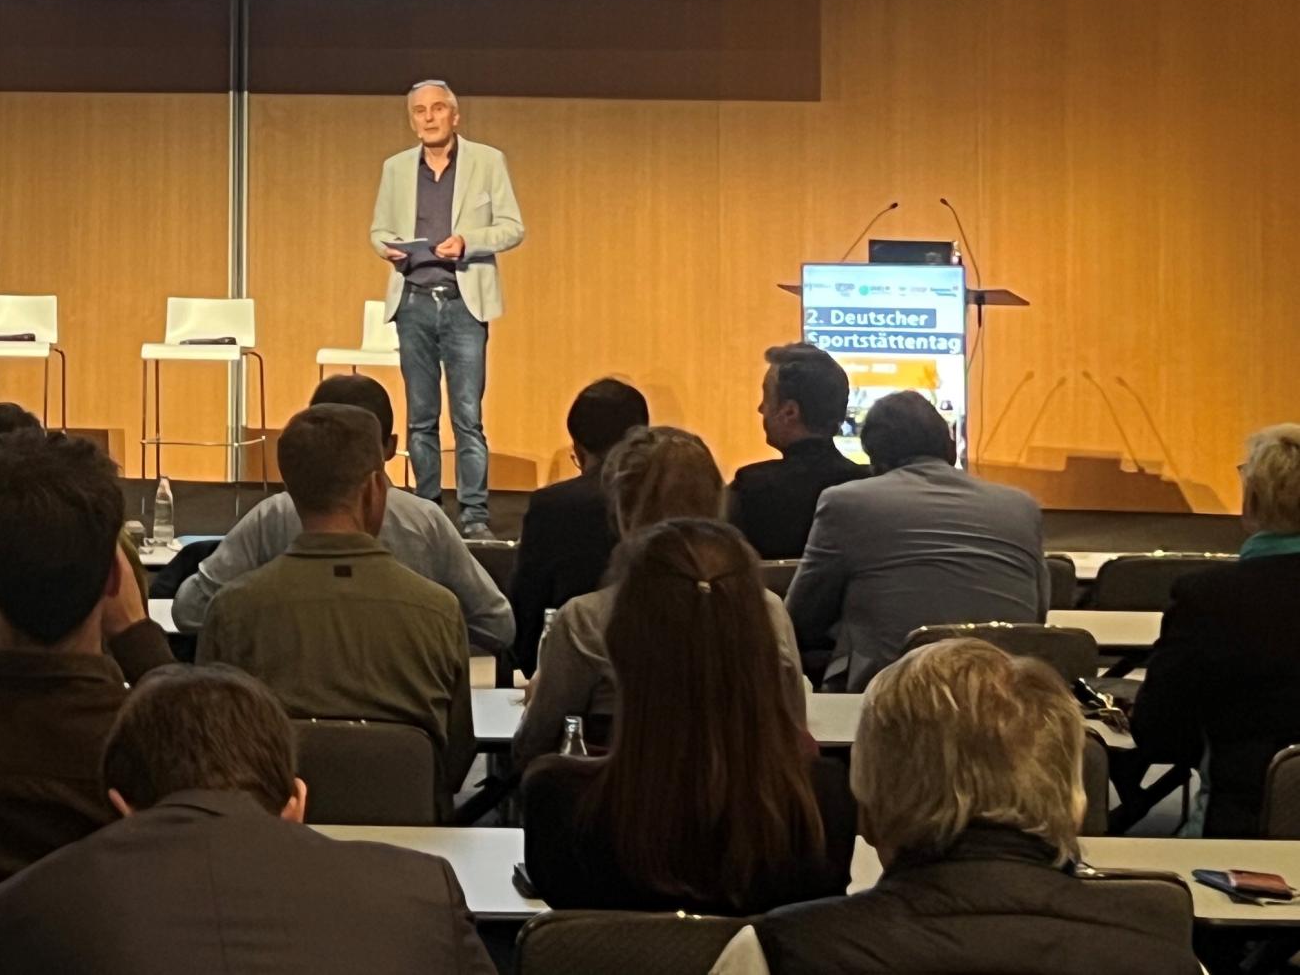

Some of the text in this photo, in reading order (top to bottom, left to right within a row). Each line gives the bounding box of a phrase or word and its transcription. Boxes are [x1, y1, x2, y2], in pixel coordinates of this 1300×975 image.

[806, 309, 929, 326] 2. Deutscher
[807, 332, 962, 355] Sportstättentag
